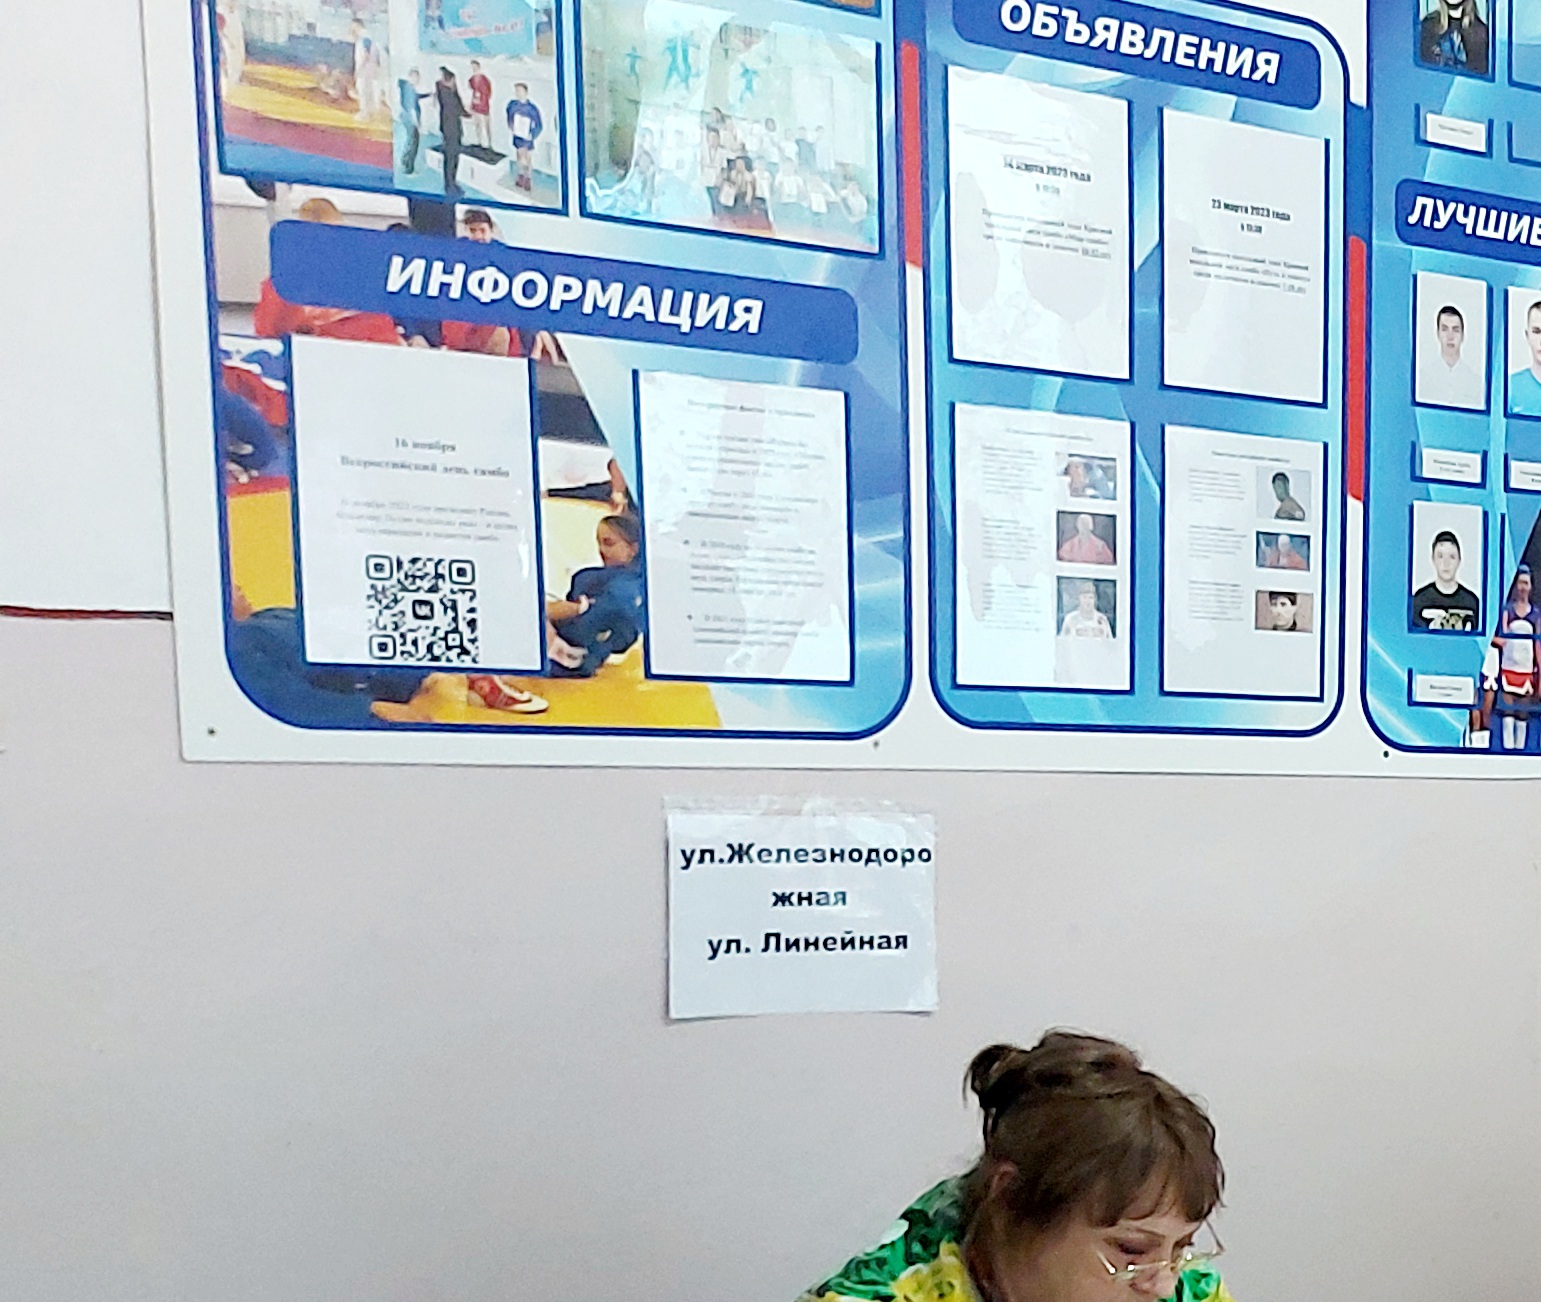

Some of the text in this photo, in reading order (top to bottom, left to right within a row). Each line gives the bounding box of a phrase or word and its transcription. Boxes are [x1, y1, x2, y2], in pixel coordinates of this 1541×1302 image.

[1000, 0, 1281, 85] ОБЪЯВЛЕНИЯ
[386, 255, 764, 335] ИНФОРМАЦИЯ
[680, 843, 933, 871] ул.Железнодоро
[771, 890, 848, 908] жная
[707, 930, 909, 960] ул. Линейная
